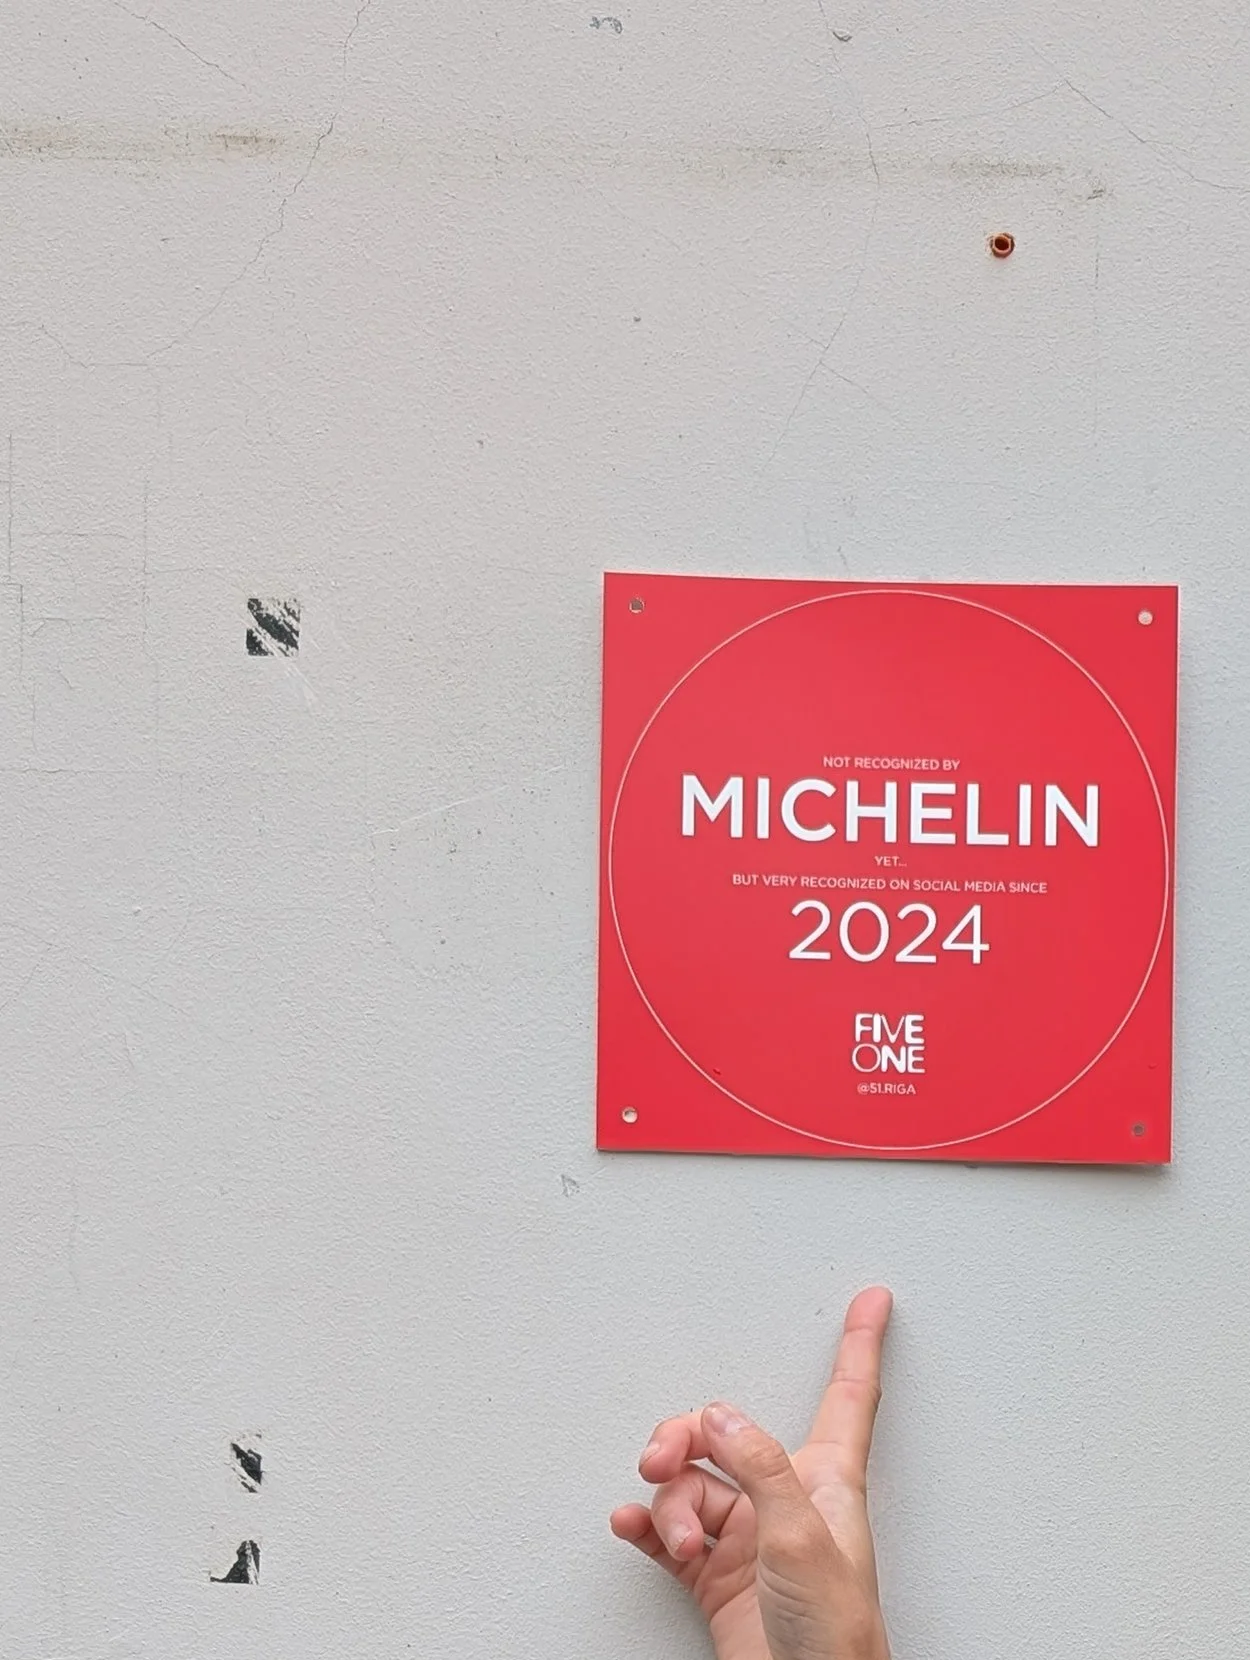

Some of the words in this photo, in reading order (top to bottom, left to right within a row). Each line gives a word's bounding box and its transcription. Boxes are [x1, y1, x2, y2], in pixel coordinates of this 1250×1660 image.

[823, 756, 850, 768] NOT
[854, 757, 940, 770] RECOGNIZED
[942, 759, 961, 771] BY
[681, 773, 1099, 848] MICHELIN
[874, 855, 907, 867] YET...
[732, 873, 759, 886] BUT
[762, 875, 798, 887] VERY
[800, 876, 886, 890] RECOGNIZED
[889, 879, 910, 891] ON
[912, 879, 961, 892] SOCIAL
[964, 881, 1006, 893] MEDIA
[1009, 881, 1048, 894] SINCE
[788, 899, 991, 965] 2024
[855, 1012, 925, 1044] FIVE
[851, 1043, 926, 1074] ONE
[856, 1082, 917, 1095] @51.RIGA
